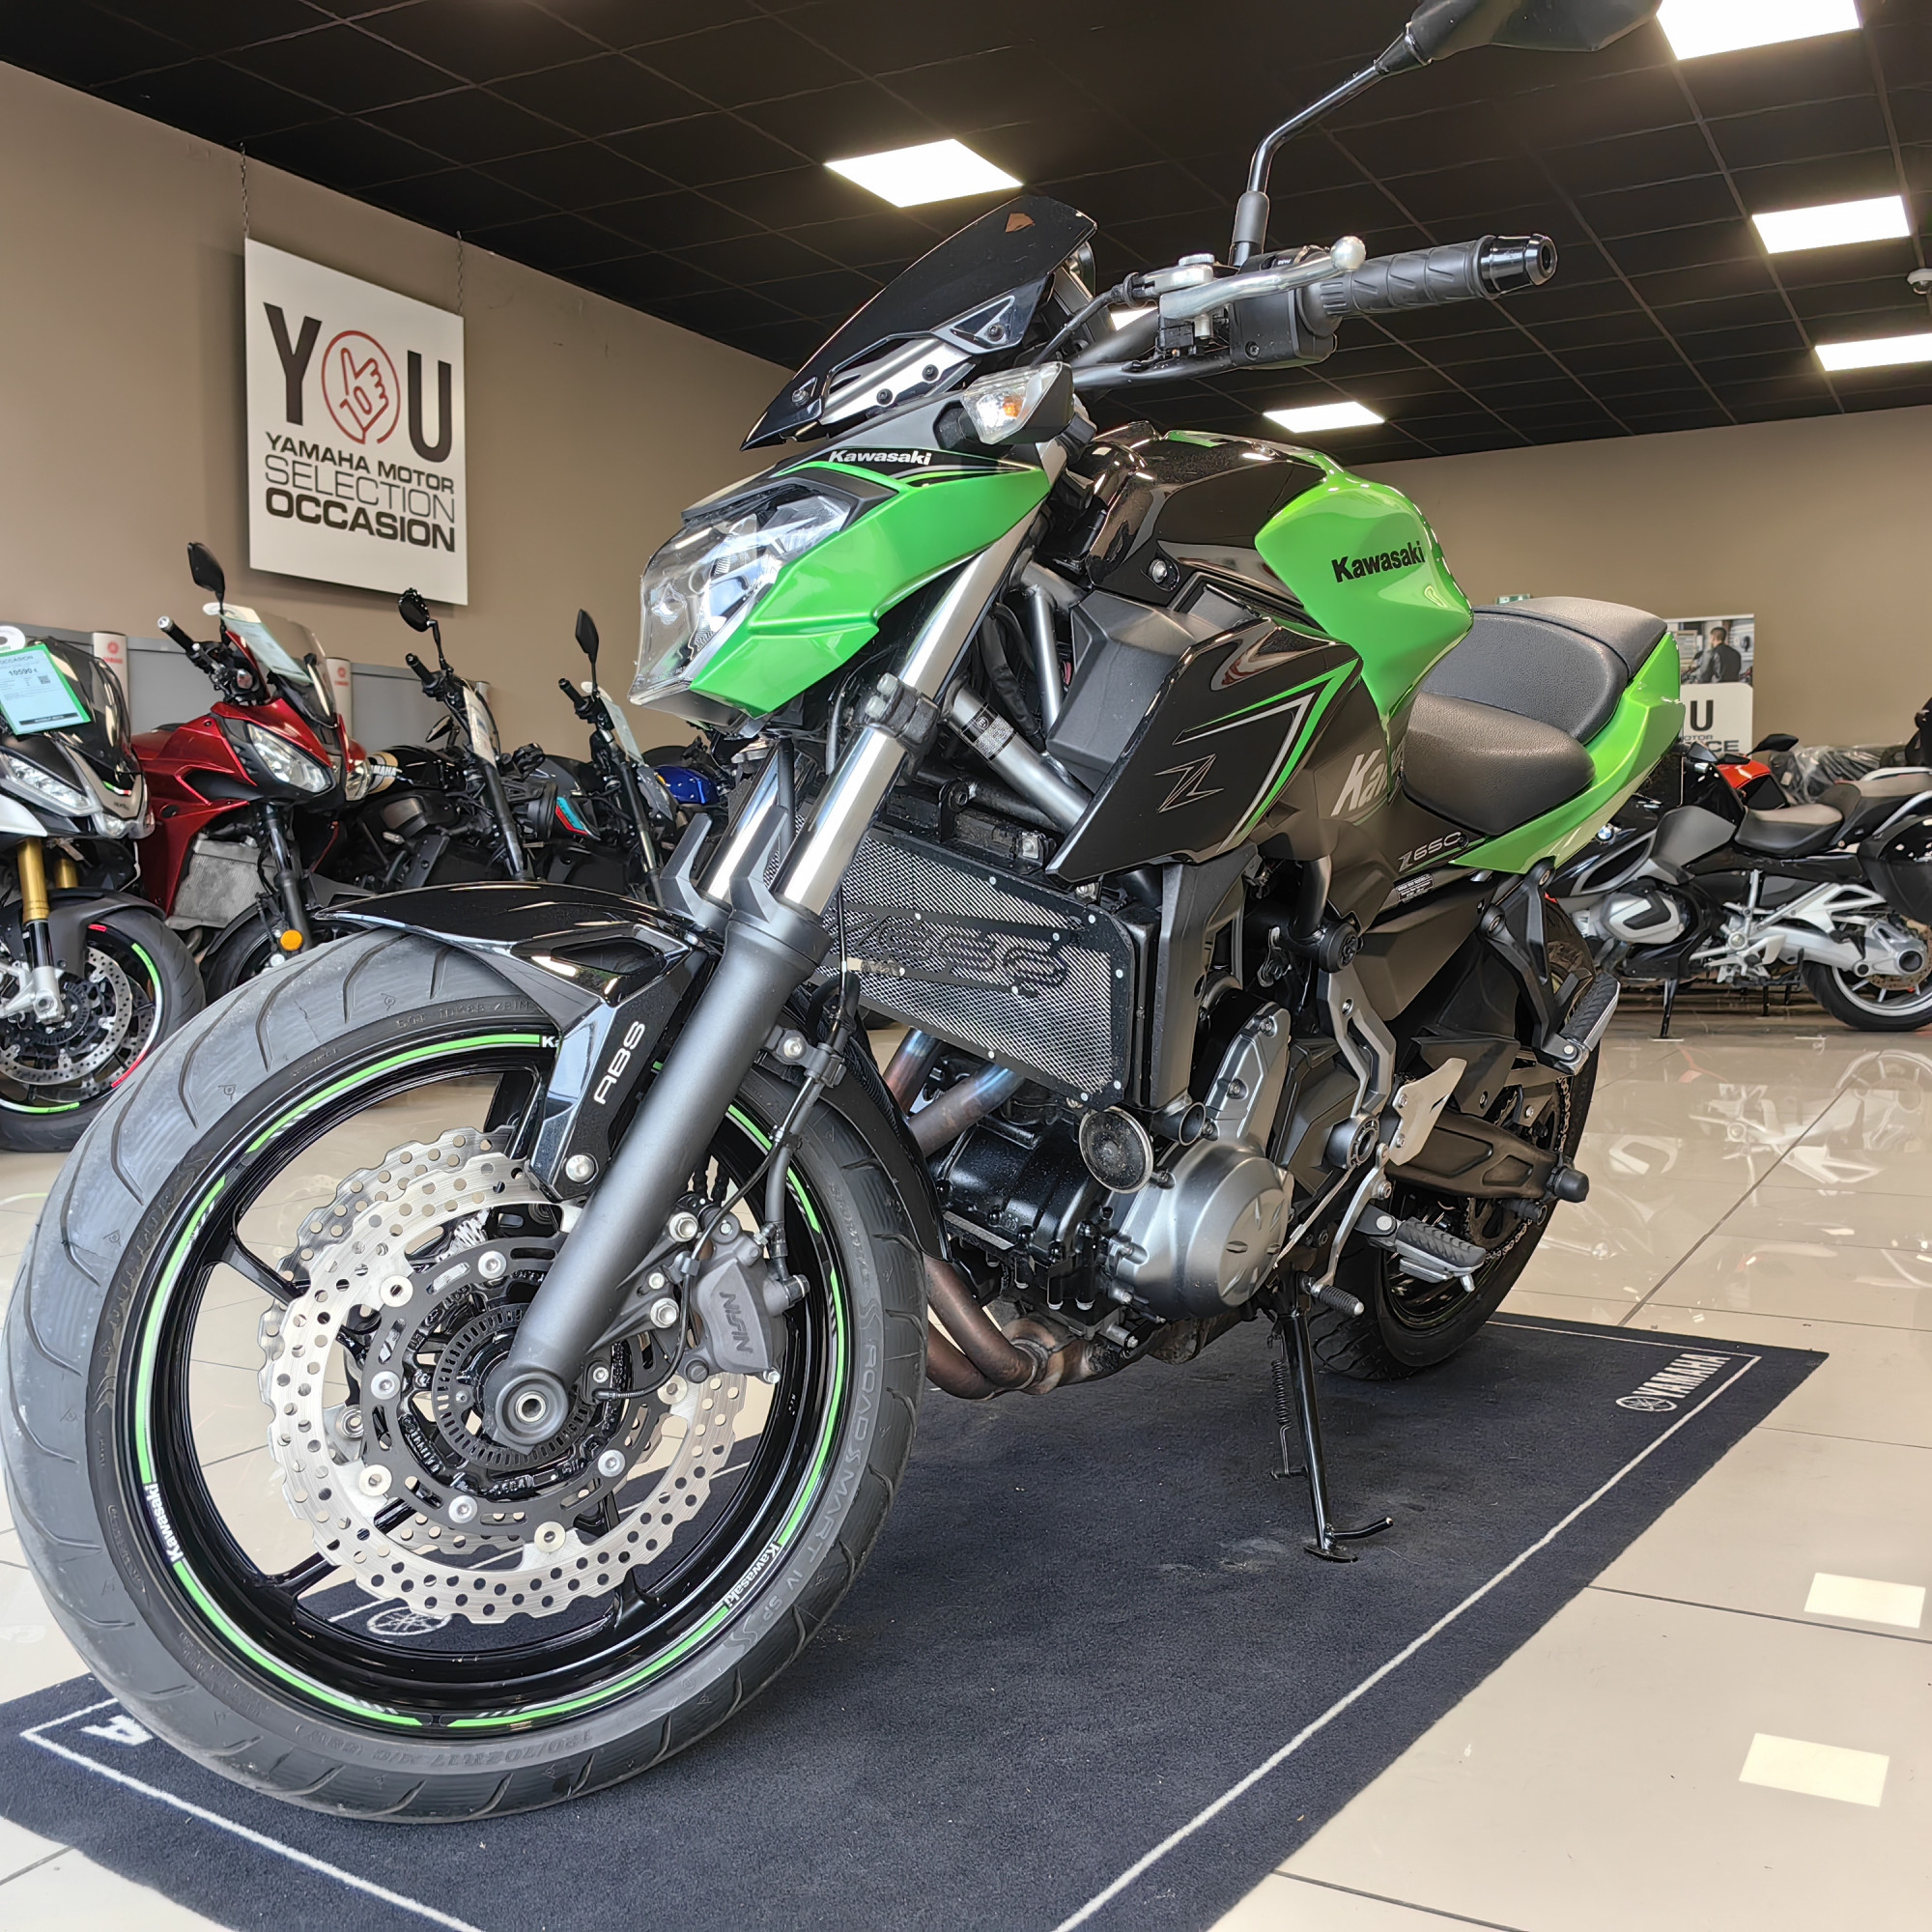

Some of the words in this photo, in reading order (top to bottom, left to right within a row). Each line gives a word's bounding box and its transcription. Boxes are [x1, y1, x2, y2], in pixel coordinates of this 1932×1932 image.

[265, 454, 455, 524] SELECTION
[266, 431, 372, 474] YAMAHA
[378, 461, 455, 495] MOTOR
[828, 449, 932, 466] Kawasaki
[266, 487, 456, 553] OCCASION
[1331, 541, 1425, 583] Kawasaki
[9, 668, 33, 676] 10590
[593, 1021, 645, 1104] ABS
[1632, 1353, 1731, 1399] YAMAHA
[144, 1483, 185, 1562] Kawasaki
[724, 1542, 783, 1609] Kawasaki
